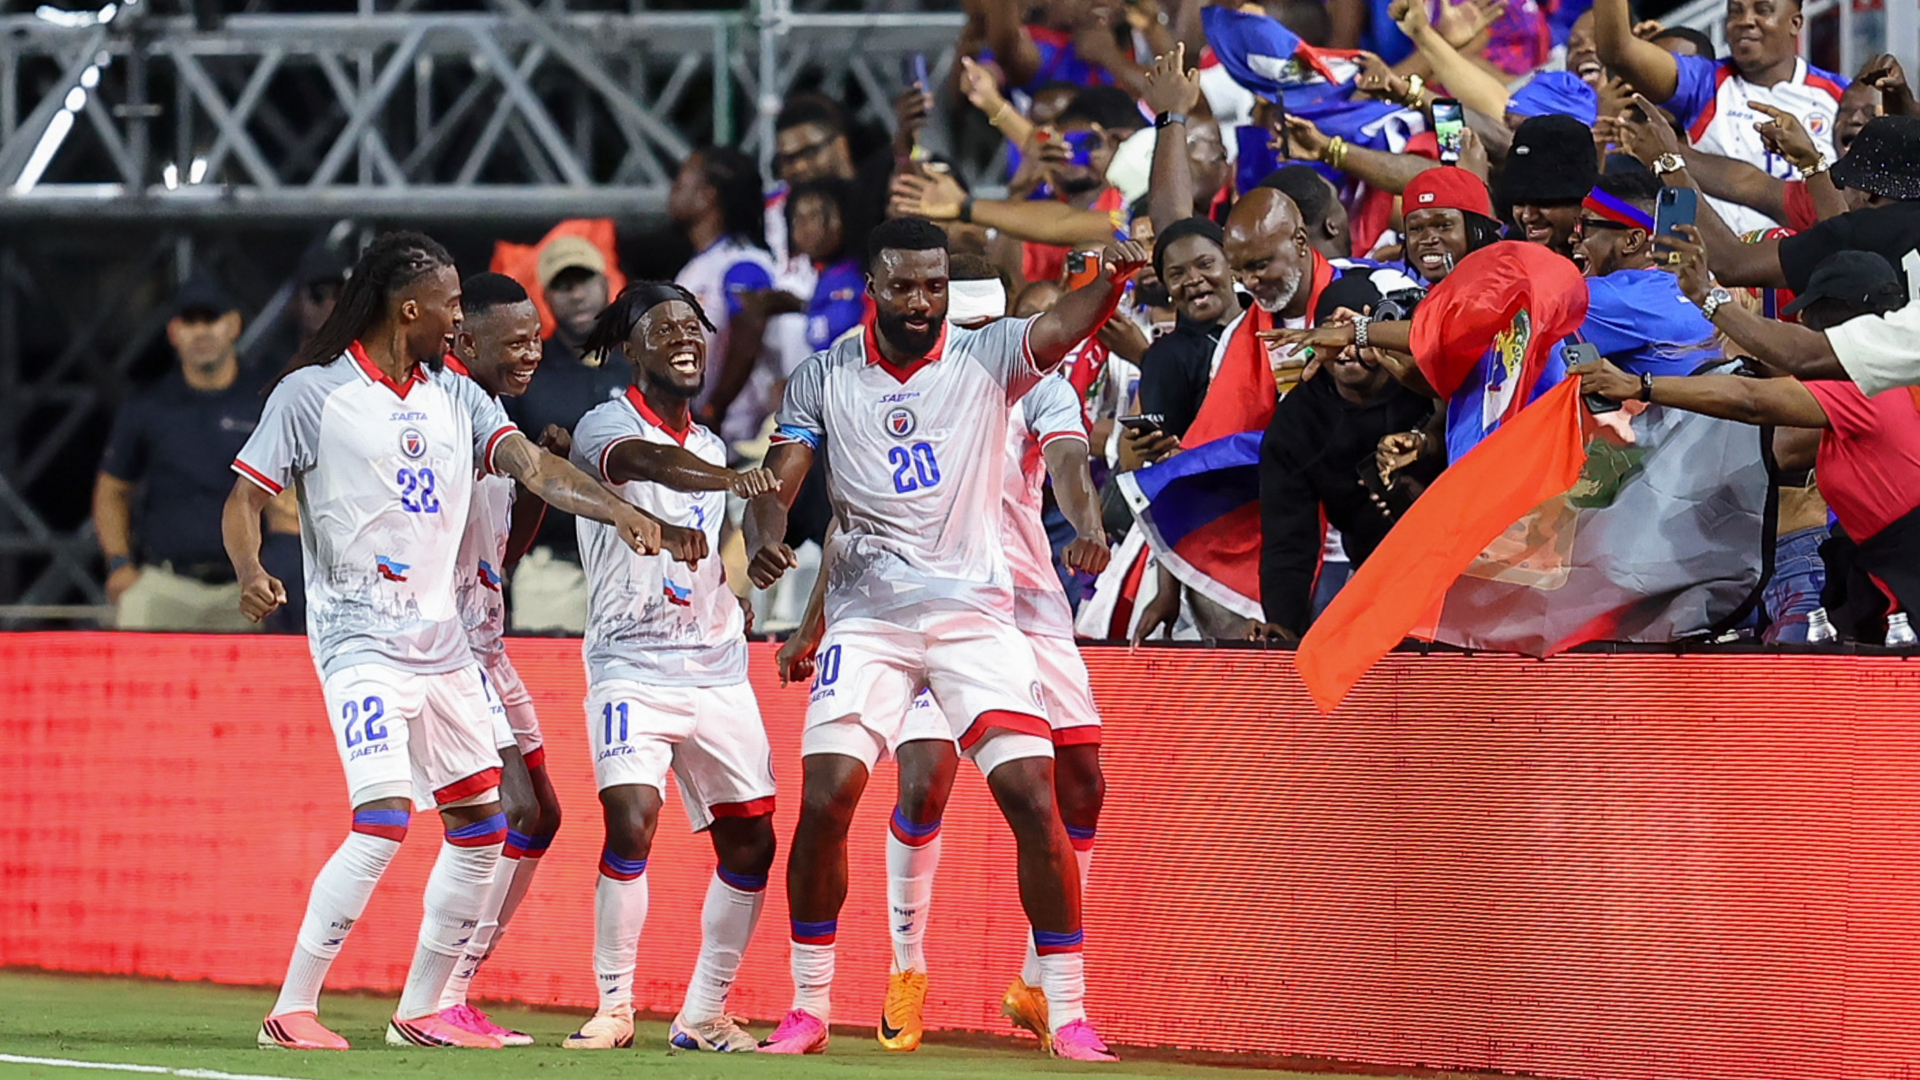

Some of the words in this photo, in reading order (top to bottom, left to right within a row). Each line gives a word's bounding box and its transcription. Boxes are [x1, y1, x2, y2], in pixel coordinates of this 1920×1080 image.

[879, 392, 921, 403] SAETA
[389, 412, 428, 421] SAETA
[888, 442, 941, 494] 20
[397, 467, 439, 514] 22
[342, 695, 388, 748] 22
[602, 701, 629, 745] 11
[350, 743, 389, 762] SAETA
[598, 745, 637, 762] SAETA
